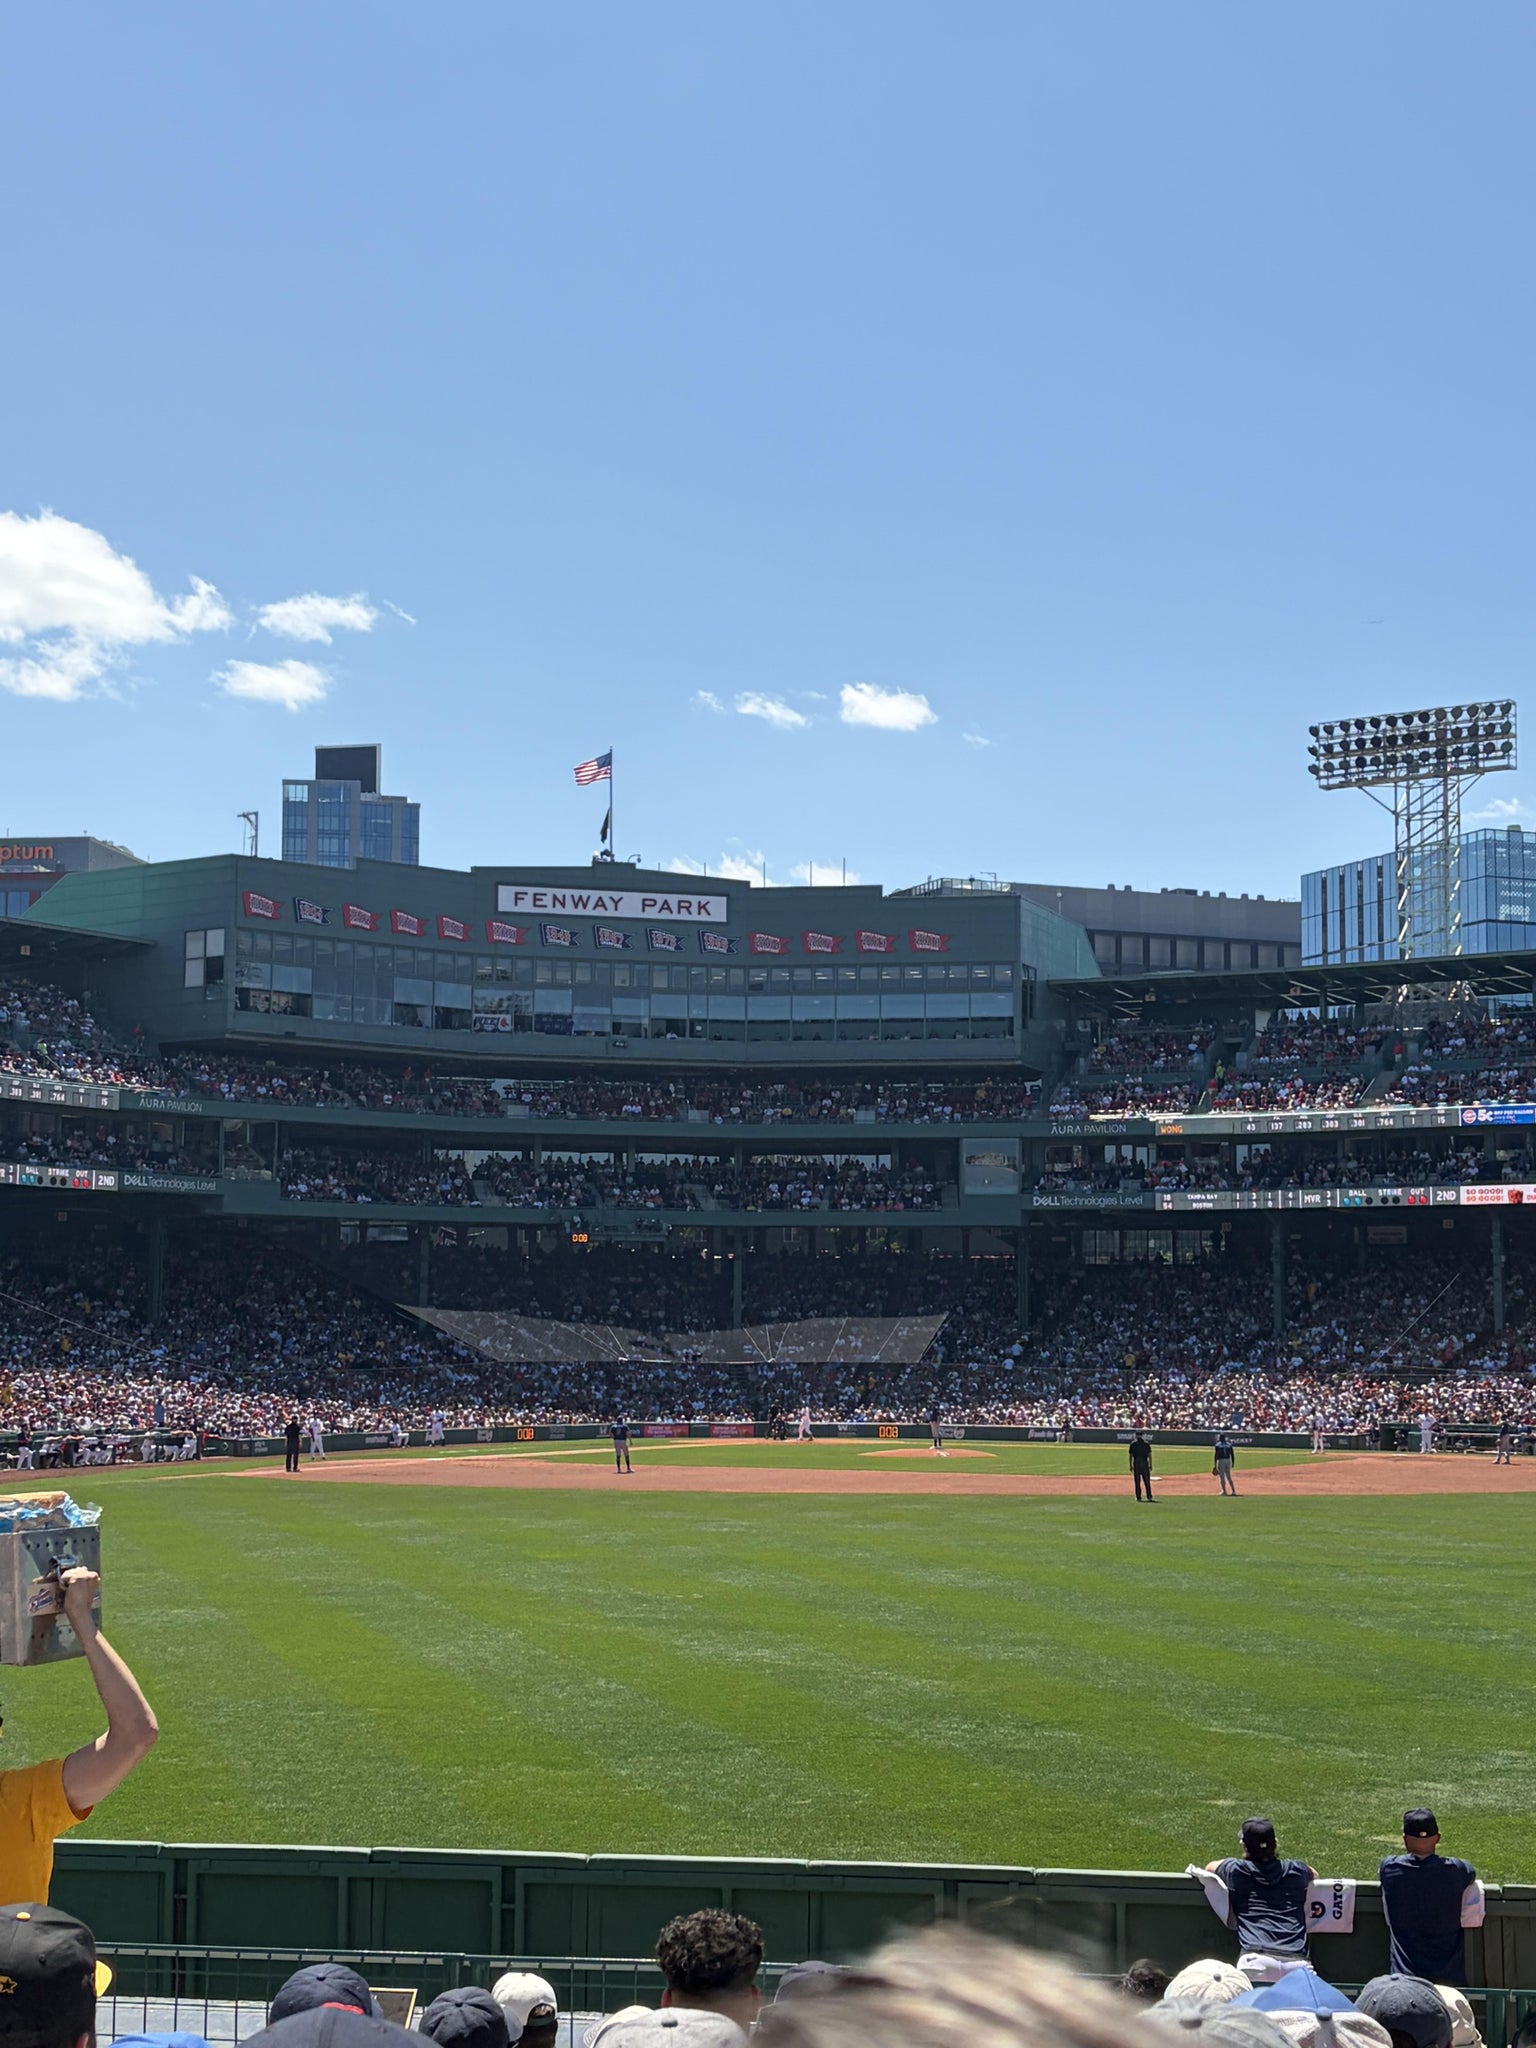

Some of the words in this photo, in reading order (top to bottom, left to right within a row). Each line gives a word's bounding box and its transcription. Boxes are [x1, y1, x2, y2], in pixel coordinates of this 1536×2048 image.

[515, 892, 624, 911] FENWAY
[642, 898, 712, 916] PARK
[101, 1097, 108, 1106] 15
[167, 1100, 202, 1113] PAVILION
[1437, 1116, 1446, 1124] 15
[1084, 1124, 1127, 1134] PAVILION
[1160, 1125, 1183, 1135] WONG
[26, 1166, 39, 1175] BALL
[48, 1168, 69, 1177] STRIKE
[76, 1170, 88, 1178] OUT
[98, 1175, 115, 1187] 2ND
[124, 1174, 148, 1187] DELL
[148, 1176, 196, 1191] Technologies
[197, 1180, 216, 1191] Level
[1378, 1188, 1402, 1196] STRIKE
[1436, 1191, 1456, 1201] 2ND
[1033, 1196, 1060, 1206] DELL
[1060, 1196, 1117, 1208] Technologies
[1119, 1195, 1143, 1205] Level
[1304, 1194, 1321, 1203] MVR
